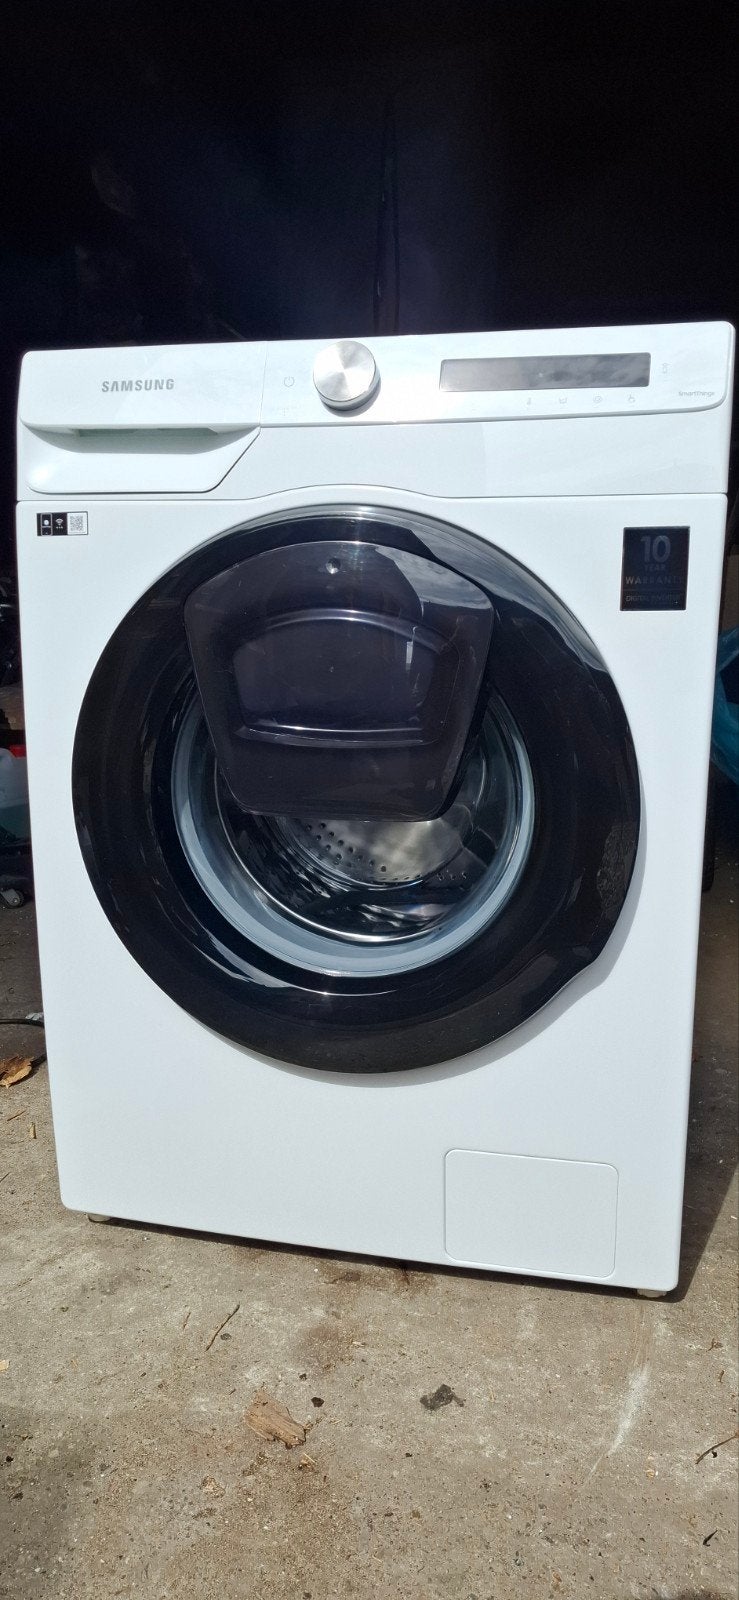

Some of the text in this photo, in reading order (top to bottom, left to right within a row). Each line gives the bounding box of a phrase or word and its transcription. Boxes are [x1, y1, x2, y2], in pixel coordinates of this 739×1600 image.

[101, 378, 175, 393] SAMSUNG
[640, 535, 671, 563] 10
[644, 563, 667, 572] YEAR
